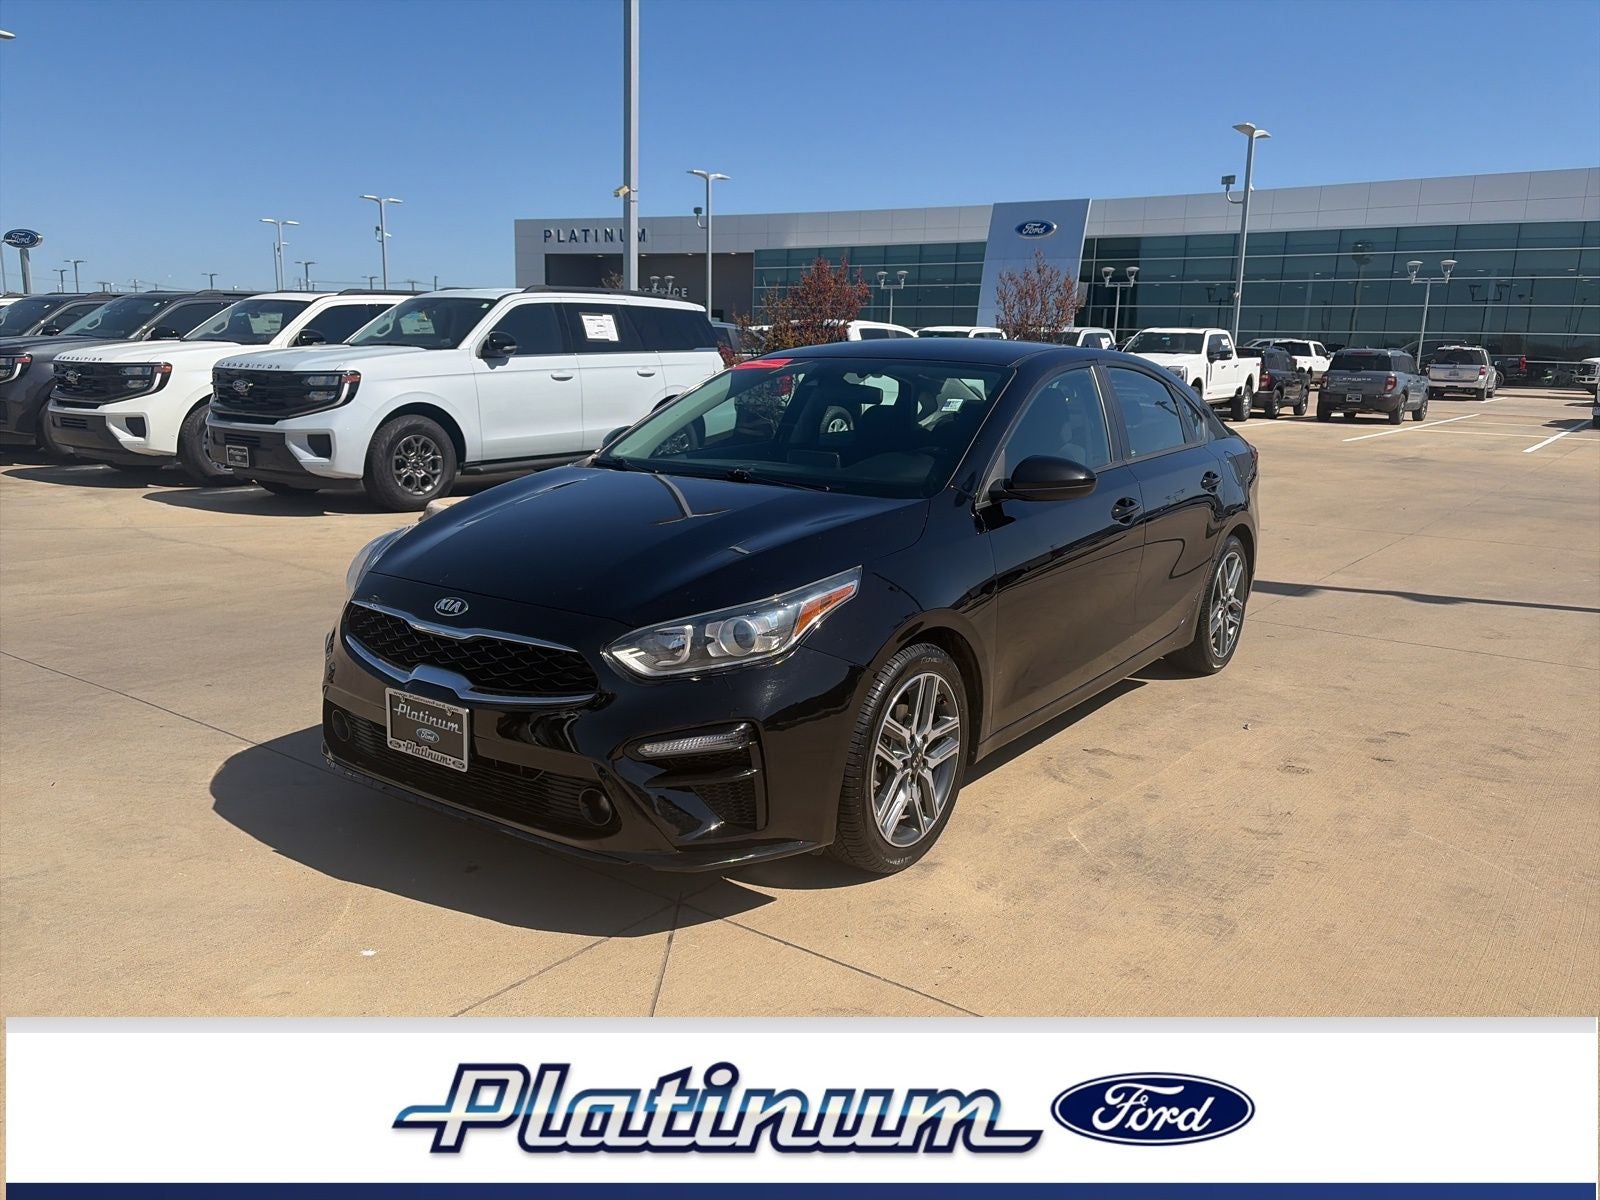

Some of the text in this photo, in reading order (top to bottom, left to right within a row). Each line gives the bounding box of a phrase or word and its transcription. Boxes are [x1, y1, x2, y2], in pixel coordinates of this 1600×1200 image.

[1022, 223, 1047, 235] Ford
[437, 598, 462, 613] KIA
[393, 703, 463, 735] Platinum
[420, 730, 435, 742] Ford
[404, 740, 451, 766] Platinum
